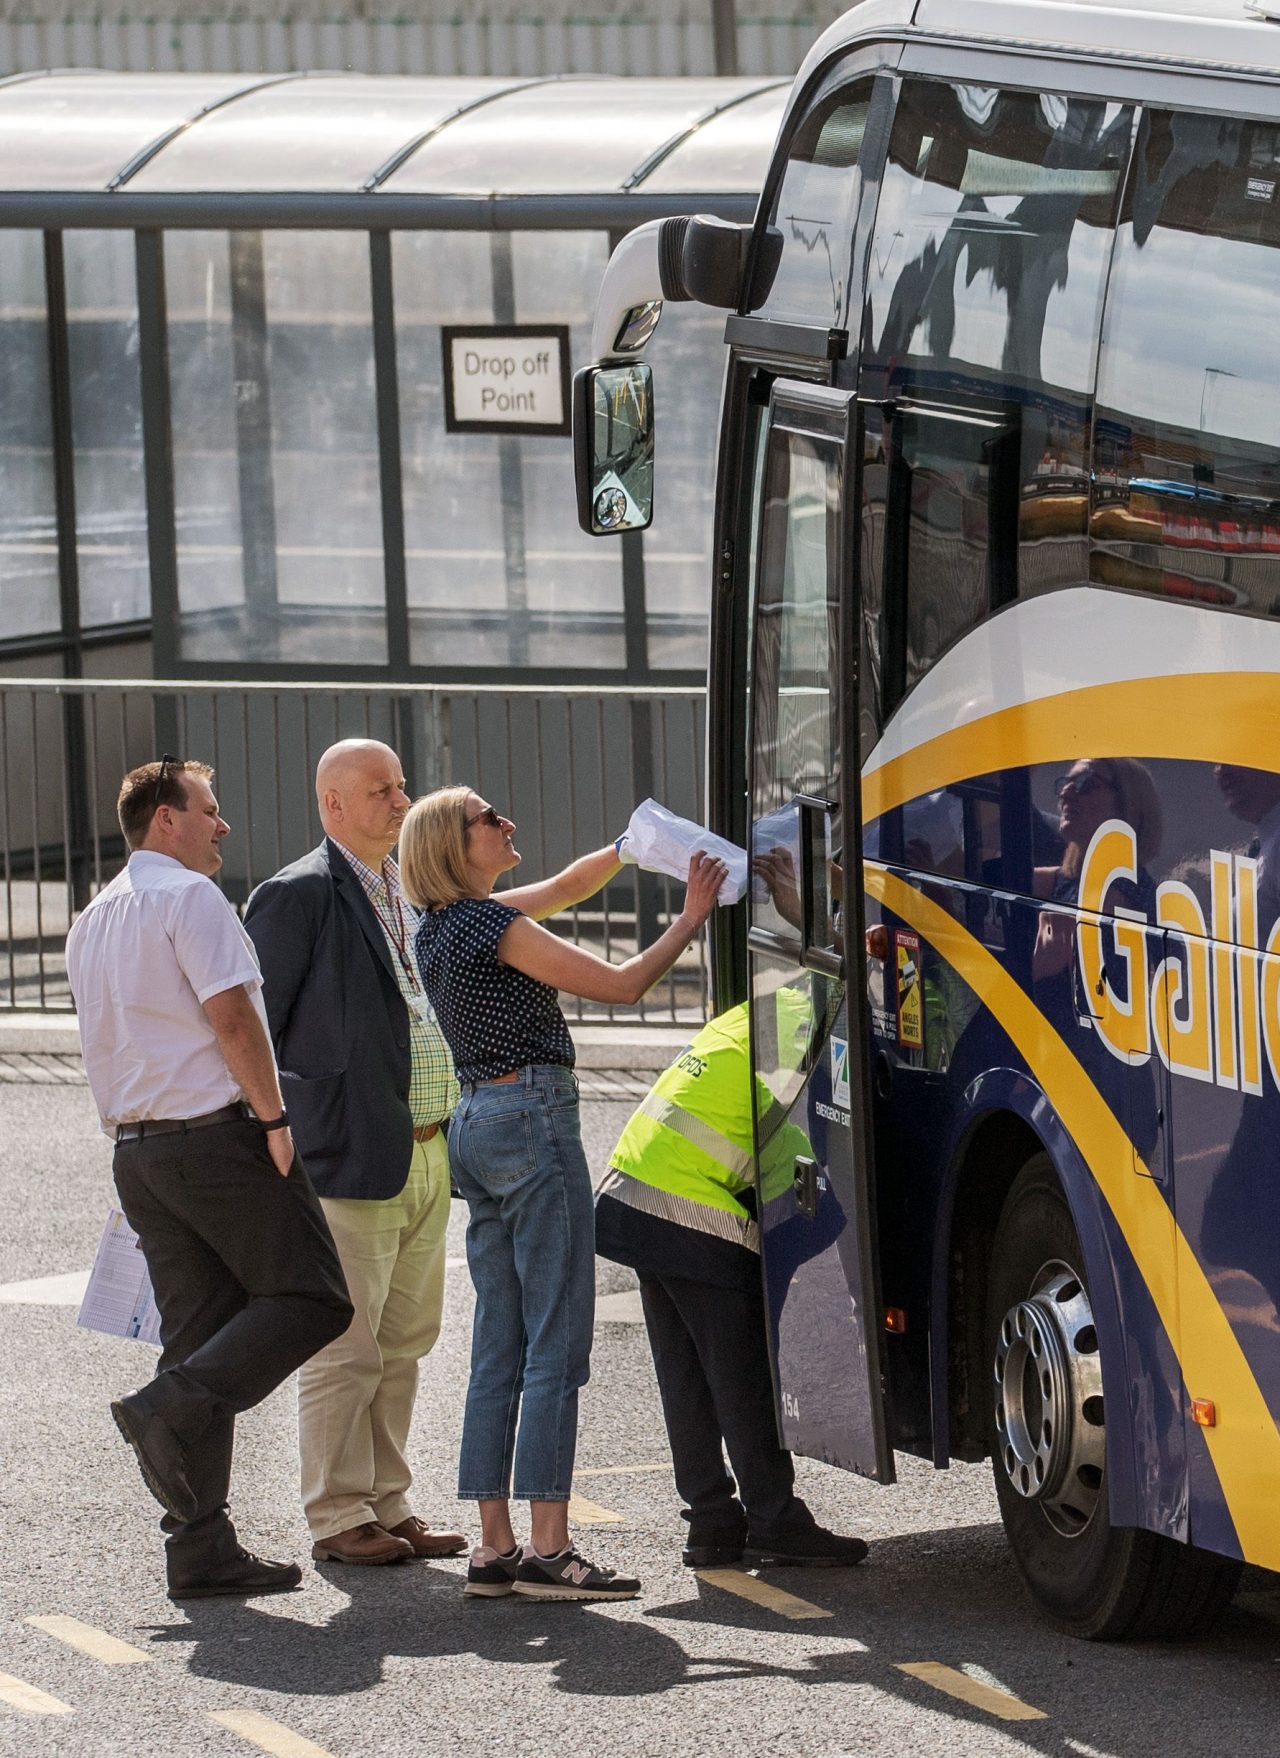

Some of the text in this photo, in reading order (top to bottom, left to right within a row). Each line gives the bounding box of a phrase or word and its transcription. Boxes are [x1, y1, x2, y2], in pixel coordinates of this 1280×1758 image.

[464, 351, 550, 381] Drop off
[481, 386, 536, 412] Point
[902, 1011, 919, 1026] ANGLES
[678, 1054, 707, 1077] DFDS
[815, 1101, 840, 1123] EMERGENCY
[816, 1176, 827, 1191] PULL
[782, 1391, 800, 1421] 154
[561, 1560, 591, 1584] N
